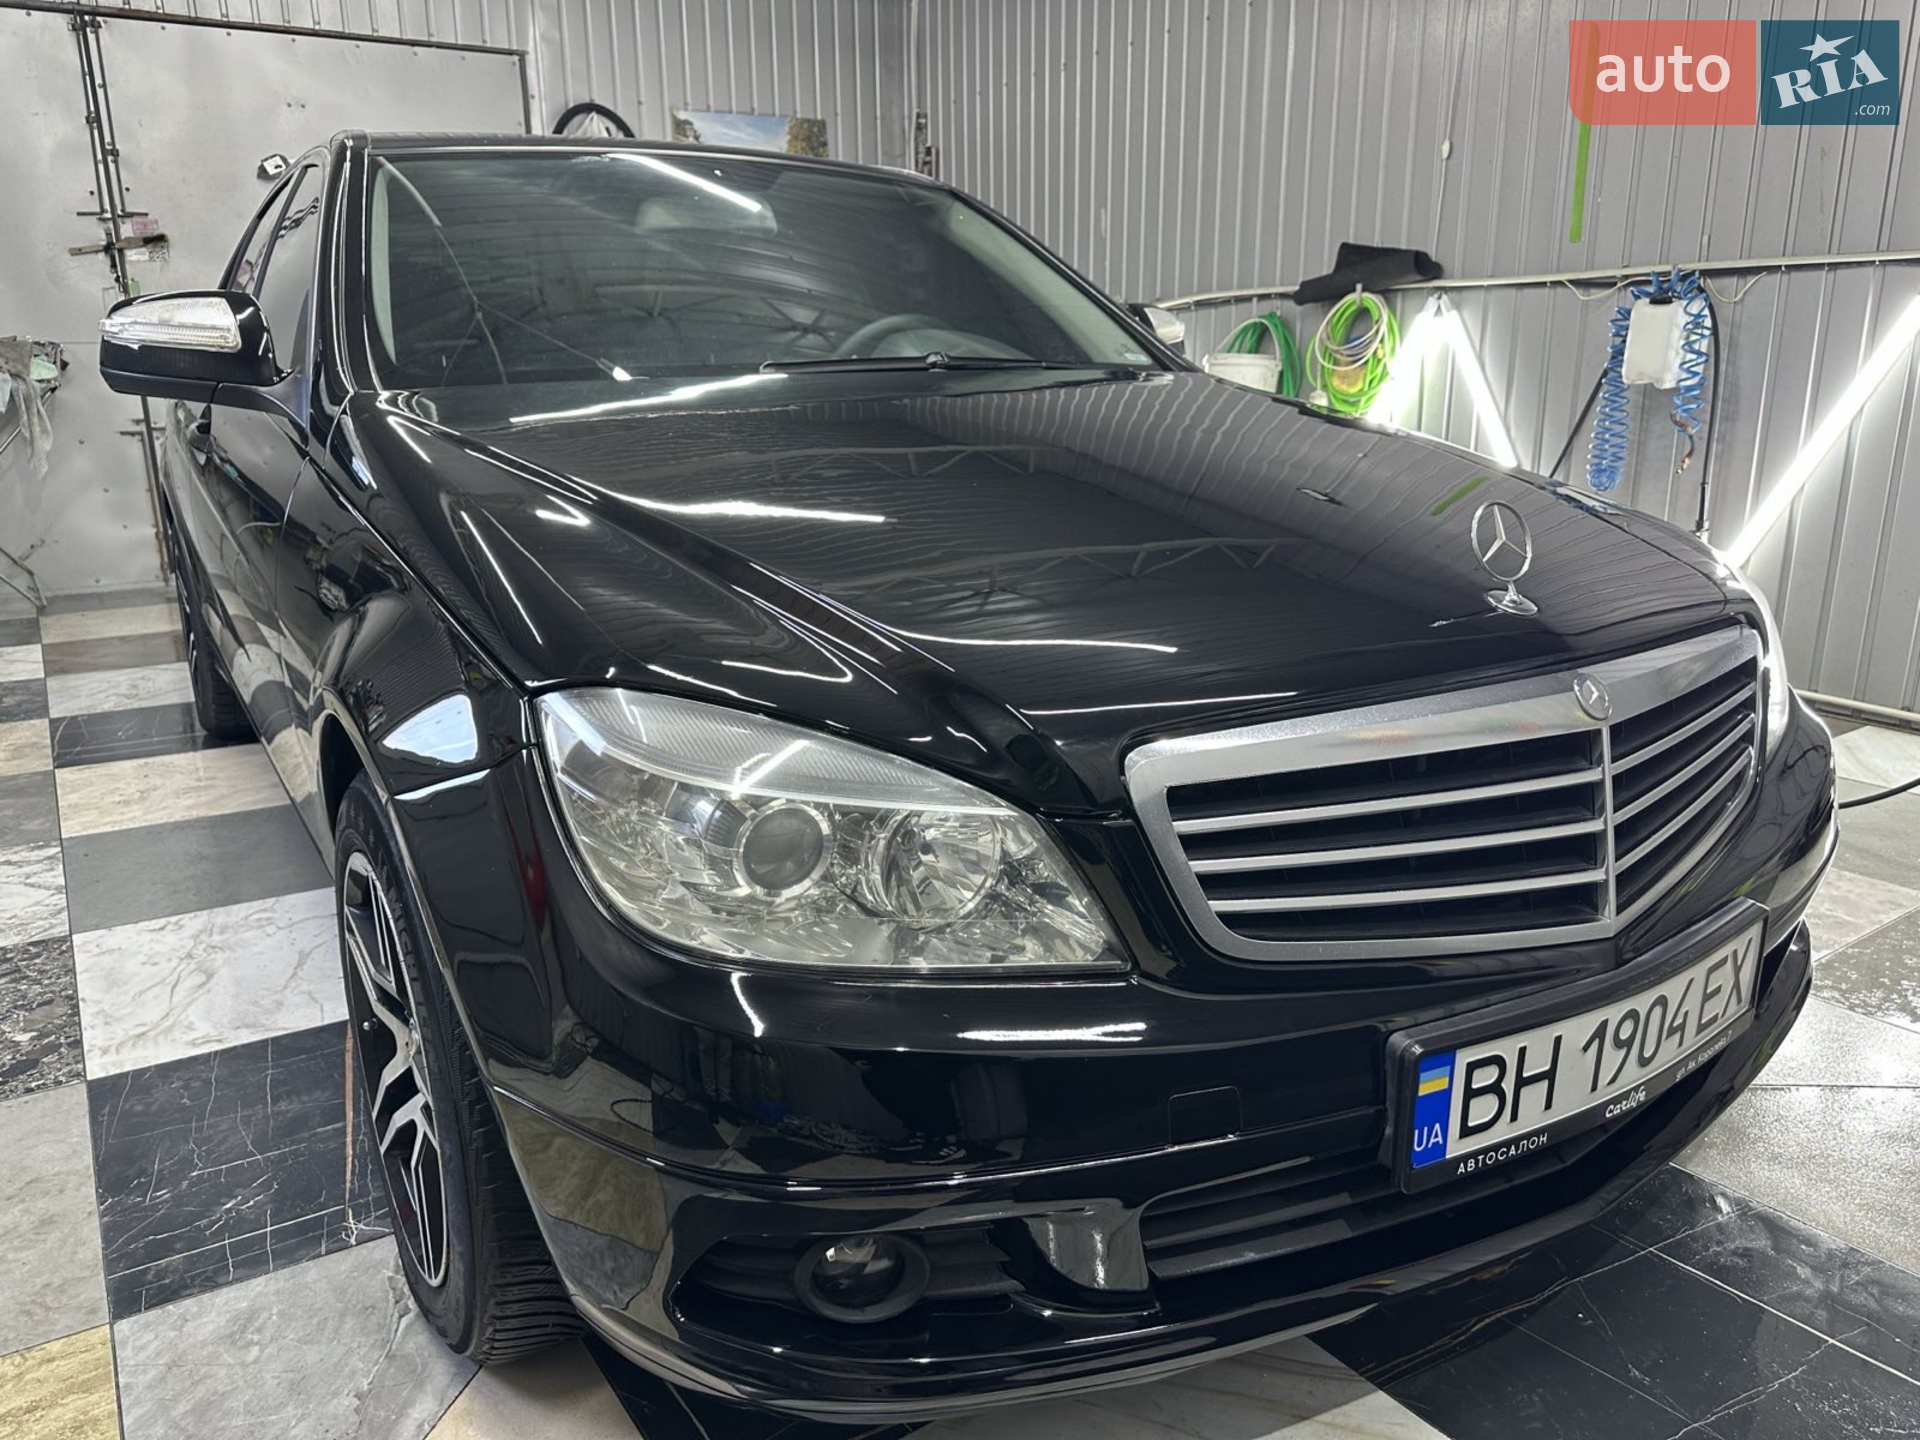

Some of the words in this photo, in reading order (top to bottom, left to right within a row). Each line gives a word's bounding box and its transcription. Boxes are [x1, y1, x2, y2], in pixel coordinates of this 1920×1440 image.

[1459, 1034, 1563, 1140] BH
[1581, 977, 1695, 1093] 1904
[1696, 936, 1753, 1037] EX
[1413, 1122, 1443, 1151] UA
[1457, 1132, 1548, 1175] АВТОСАЛОН
